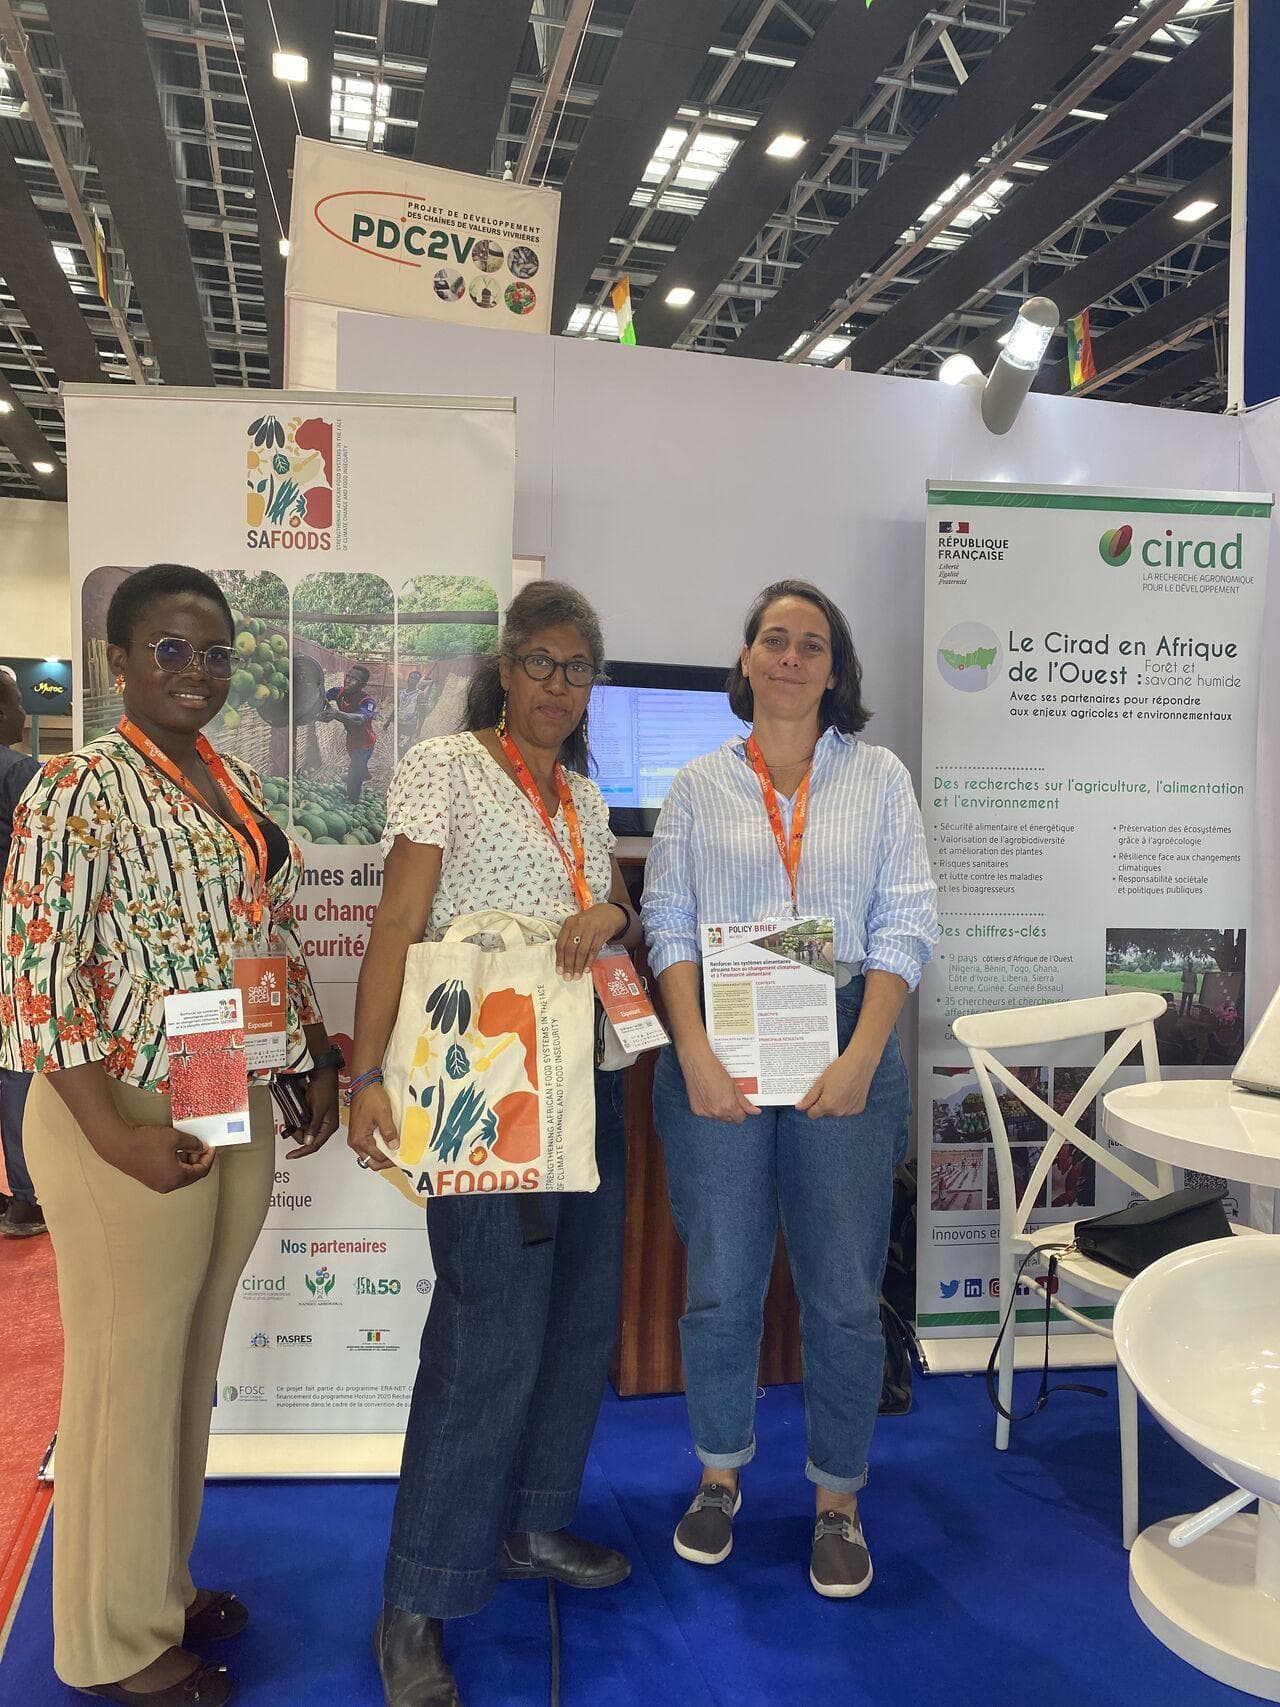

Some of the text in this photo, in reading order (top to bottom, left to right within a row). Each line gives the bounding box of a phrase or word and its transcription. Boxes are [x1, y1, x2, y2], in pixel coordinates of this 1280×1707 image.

[408, 202, 444, 215] PROJET
[447, 210, 459, 218] DE
[407, 211, 422, 220] DES
[457, 221, 467, 229] DE
[468, 223, 501, 235] VALEURS
[352, 213, 476, 264] PDC2V
[247, 530, 331, 550] SAFOODS
[938, 536, 1009, 550] RÉPUBLIQUE
[938, 549, 1004, 561] FRANÇAISE
[1142, 529, 1242, 570] cirad
[1142, 573, 1254, 584] LA RECHERCHE AGRONOMIQUE
[1142, 583, 1240, 594] POUR LE DÉVELOPPEMENT
[1009, 630, 1238, 661] Le Cirad en Afrique
[1008, 660, 1038, 683] de
[1145, 659, 1195, 674] Forêt et
[1145, 674, 1241, 688] savane humide
[1010, 691, 1201, 707] Avec ses partenaires pour répondre
[1010, 708, 1232, 721] aux enjeux agricoles et environnementaux
[934, 777, 1244, 795] Des recherches sur l'agriculture, l'alimentation
[933, 794, 1060, 809] et l'environnement
[940, 822, 1075, 833] Sécurité alimentaire et énergétique
[1119, 824, 1232, 834] Préservation des écosystèmes
[940, 835, 1065, 845] Valorisation de l'agrobiodiversité
[1118, 836, 1140, 845] grâce
[1148, 836, 1202, 846] l'agroécologie
[939, 847, 1043, 856] et amélioration des plantes
[1119, 852, 1157, 861] Résilience
[1158, 853, 1175, 861] face
[1191, 854, 1241, 863] changements
[939, 860, 1009, 869] Risques sanitaires
[1118, 863, 1162, 873] climatiques
[939, 872, 1043, 881] et lutte contre les maladies
[1118, 875, 1209, 884] Responsabilité sociétale
[939, 885, 1015, 894] et les bioagresseurs
[1117, 886, 1203, 896] et politiques publiques
[728, 924, 777, 933] POLICY BRIEF
[965, 924, 1047, 937] chiffres-clés
[304, 933, 365, 957] curité
[949, 953, 955, 961] 9
[957, 955, 978, 964] pays
[1010, 964, 1031, 974] Togo,
[1033, 964, 1060, 973] Ghana,
[948, 974, 968, 982] Côte
[1032, 974, 1055, 983] Sierra
[948, 984, 976, 993] Leone,
[977, 984, 1007, 993] Guinée,
[945, 997, 1017, 1006] 35 chercheurs et
[248, 1020, 273, 1030] Exposant
[541, 1016, 548, 1025] IN
[541, 1026, 551, 1064] SYSTEMS
[544, 1065, 553, 1087] FOOD
[546, 1088, 554, 1123] AFRICAN
[551, 1018, 565, 1191] OF CLIMATE CHANGE AND FOOD INSECURITY
[545, 1126, 555, 1190] STRENGTHENING
[402, 1168, 541, 1196] AFOODS
[932, 1228, 987, 1240] Innovons
[281, 1237, 387, 1257] Nos partenaires
[242, 1275, 285, 1291] cirad
[276, 1335, 312, 1343] PASRES
[239, 1385, 265, 1395] FOSC
[286, 1385, 303, 1393] projet
[317, 1385, 334, 1393] partie
[345, 1385, 378, 1393] programme
